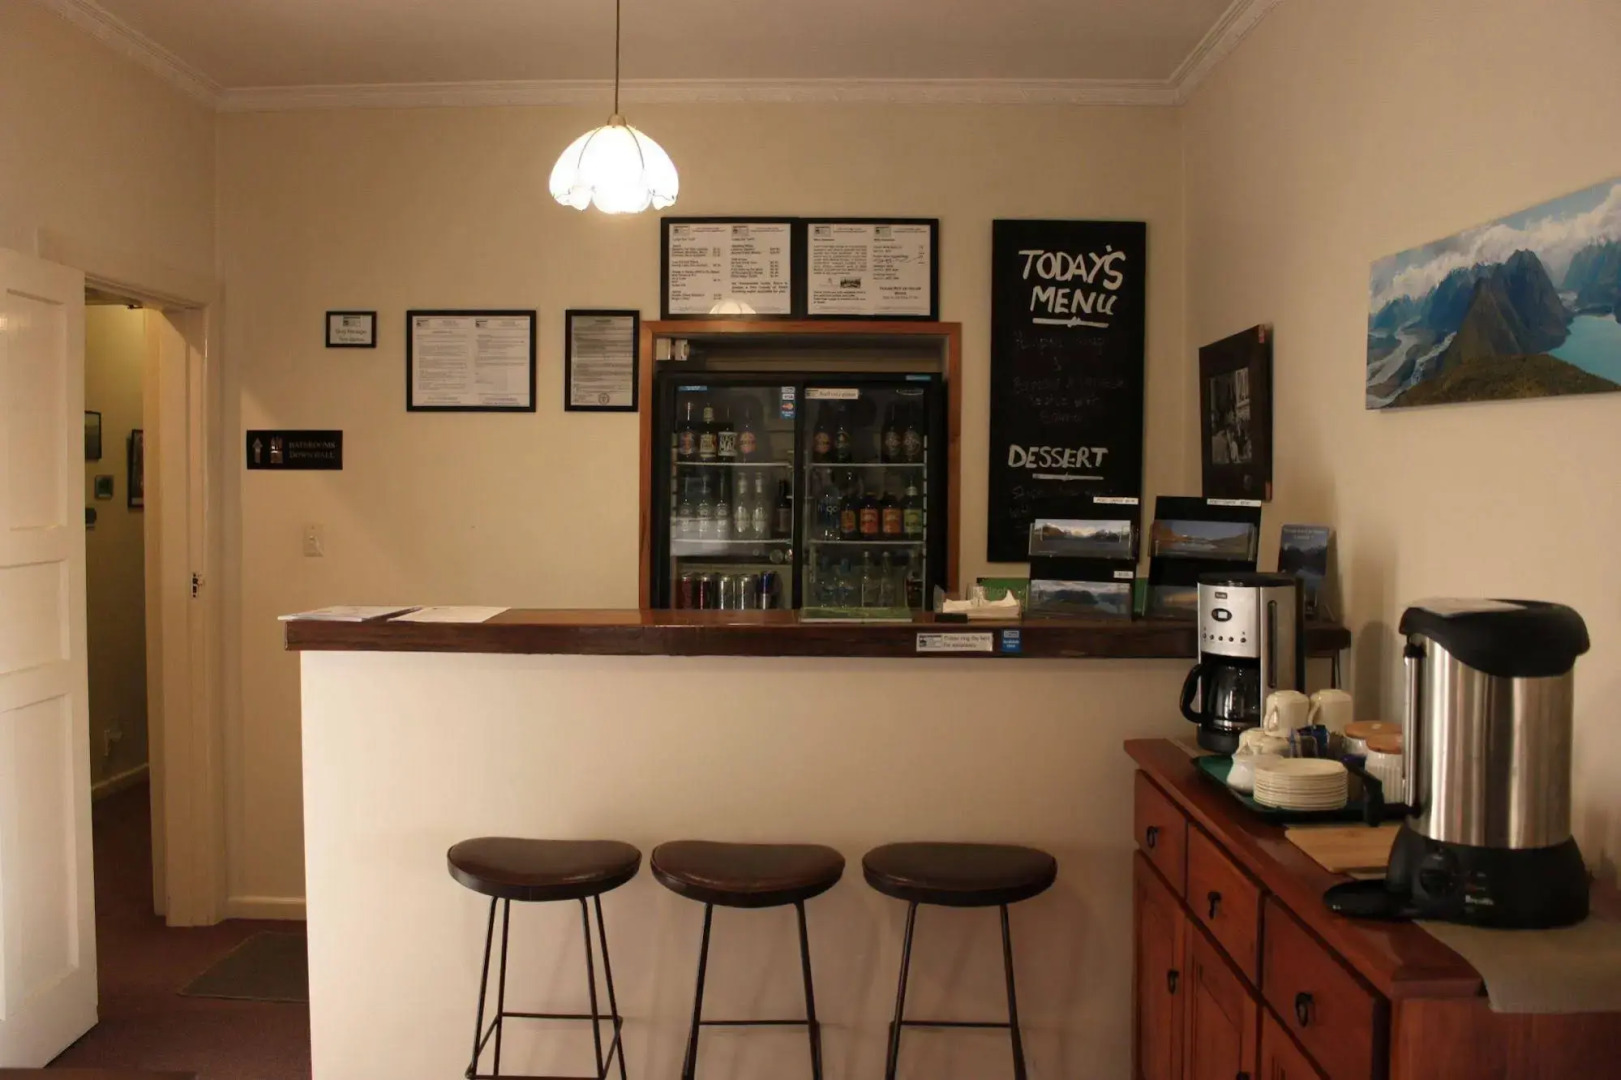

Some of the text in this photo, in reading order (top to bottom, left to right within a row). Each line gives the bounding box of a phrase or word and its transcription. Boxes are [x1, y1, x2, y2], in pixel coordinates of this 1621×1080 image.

[1018, 244, 1127, 291] TODAY'S
[1030, 285, 1118, 316] MENU
[1008, 444, 1109, 468] DESSERT
